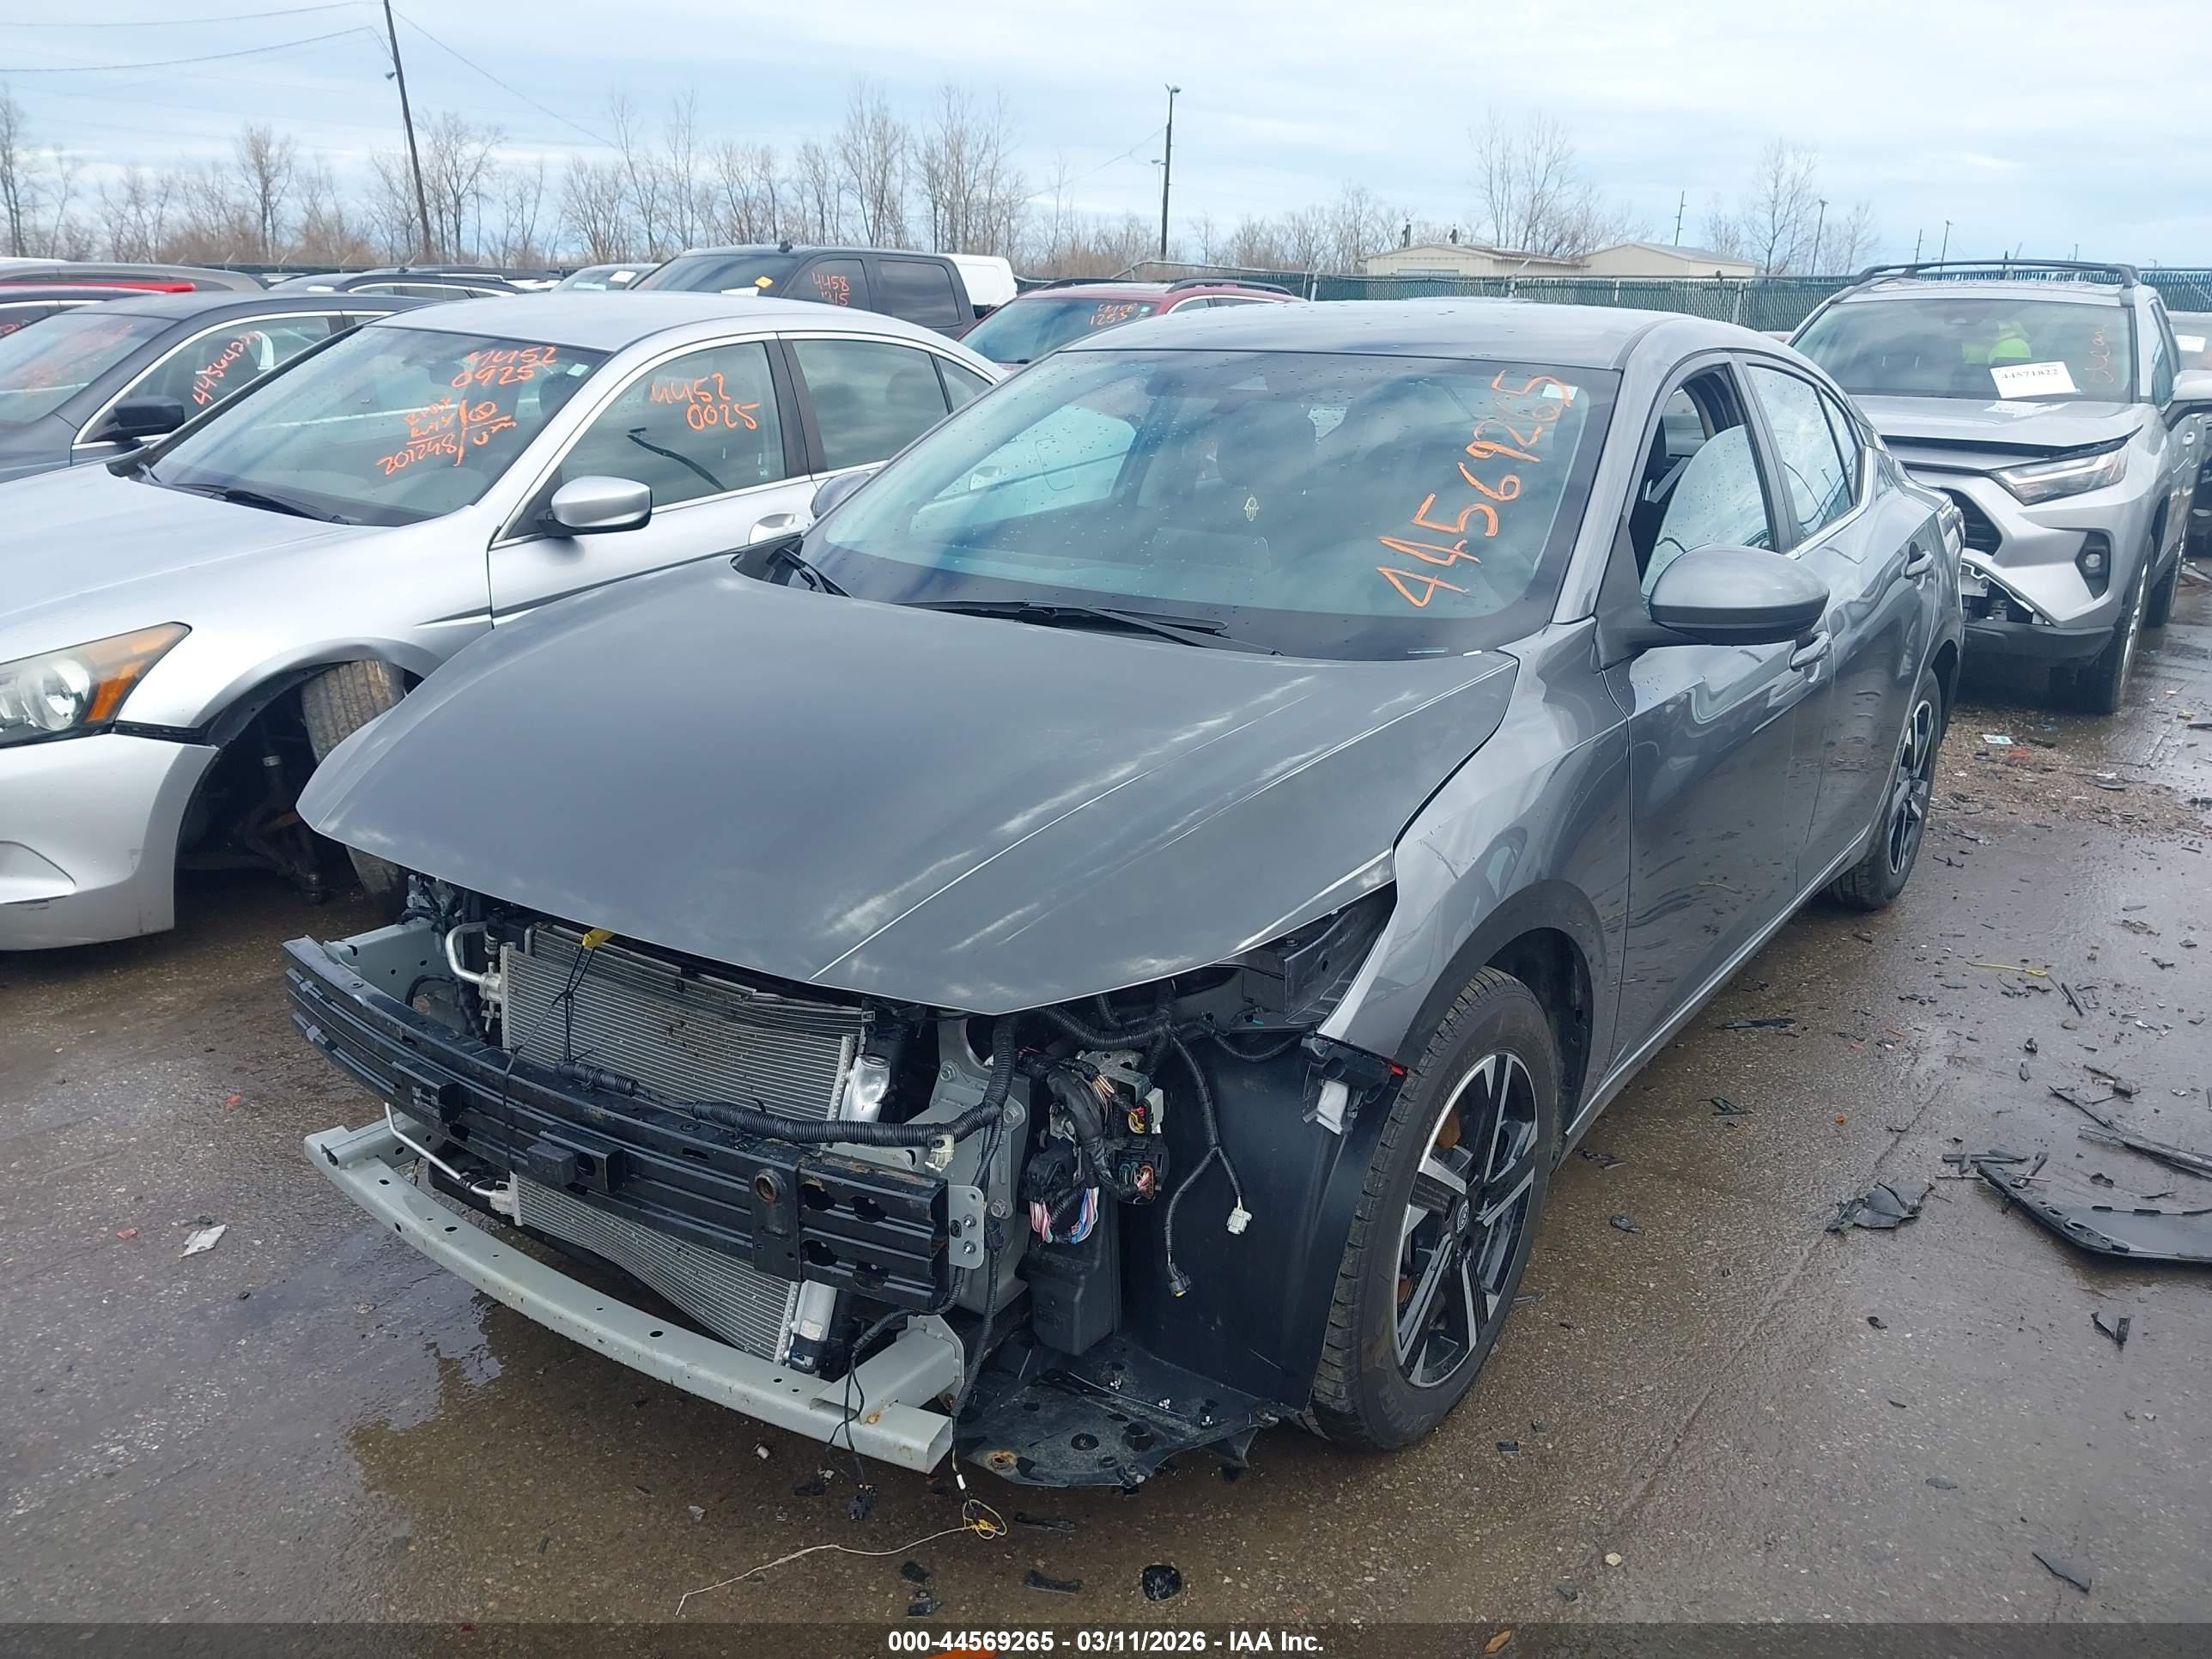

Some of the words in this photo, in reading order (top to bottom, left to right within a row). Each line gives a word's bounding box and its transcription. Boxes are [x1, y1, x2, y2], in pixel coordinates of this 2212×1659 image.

[811, 272, 849, 293] 4458
[451, 364, 536, 388] 0925
[650, 373, 731, 404] 4452
[1376, 369, 1571, 608] 44569265
